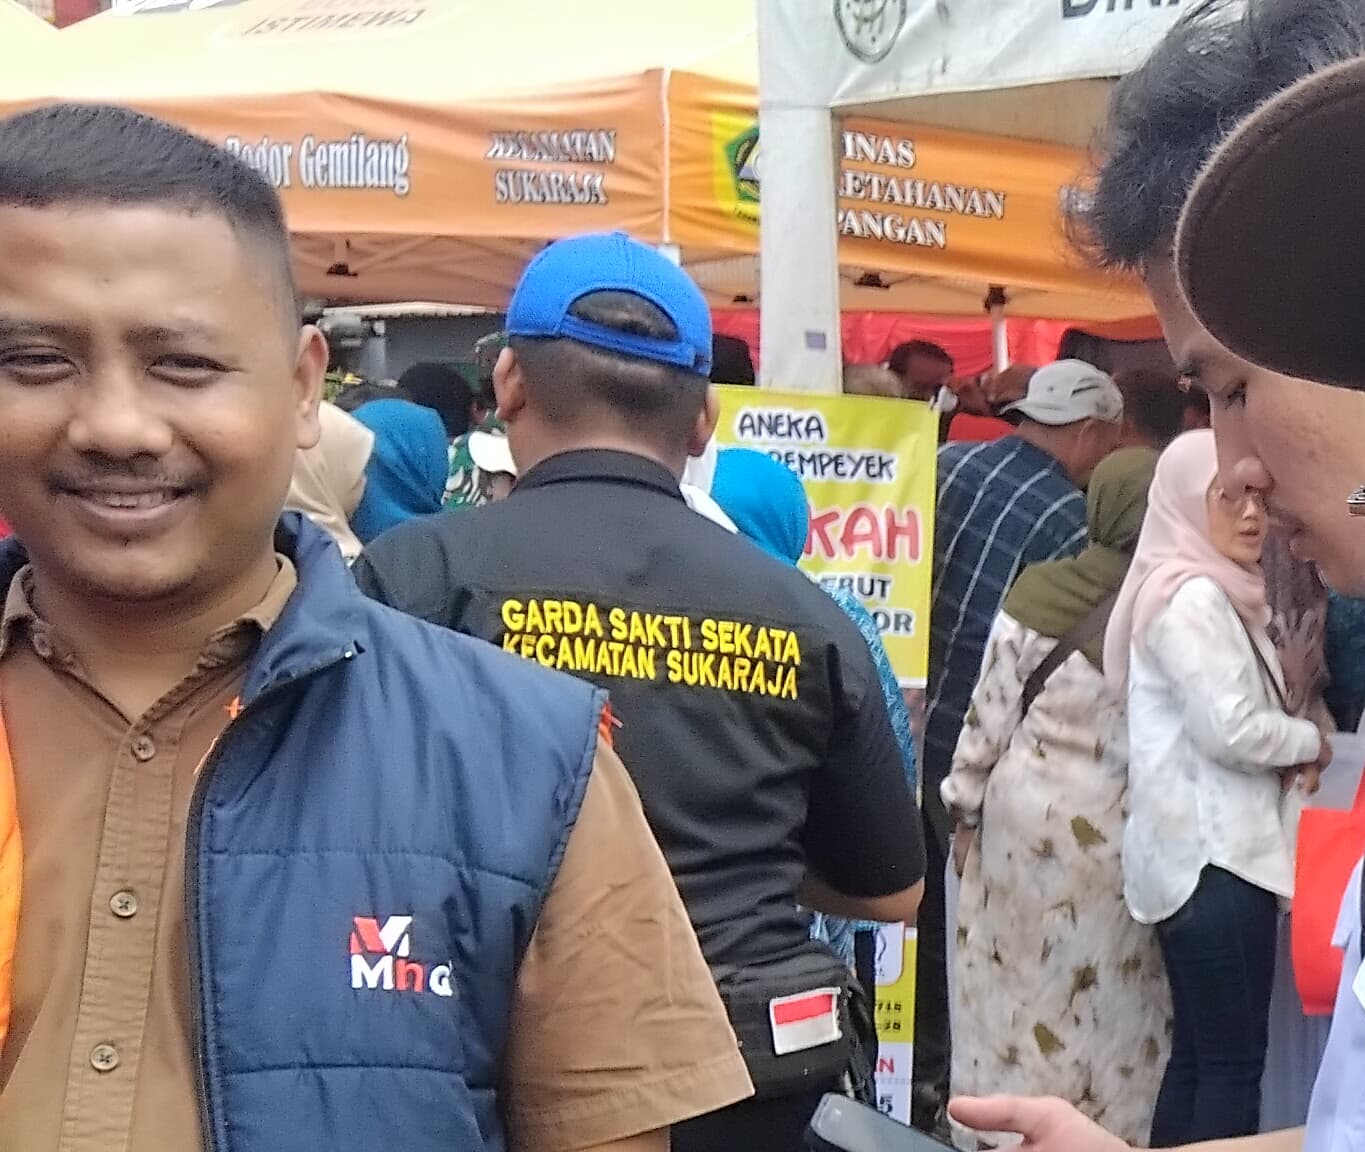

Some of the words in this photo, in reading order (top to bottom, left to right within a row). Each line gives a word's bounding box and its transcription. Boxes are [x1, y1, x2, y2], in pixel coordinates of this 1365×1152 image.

[243, 8, 426, 36] ISTIMEWA
[299, 133, 410, 195] Gemilang
[484, 129, 617, 163] KECAMATAN
[842, 130, 916, 168] INAS
[494, 168, 609, 206] SUKARAJA
[838, 169, 1006, 220] ETAHANAN
[738, 410, 824, 439] ANEKA
[501, 598, 604, 638] GARDA
[608, 607, 693, 649] SAKTI
[701, 618, 802, 666] SEKATA
[502, 632, 657, 681] KECAMATAN
[665, 649, 799, 701] SUKARAJA
